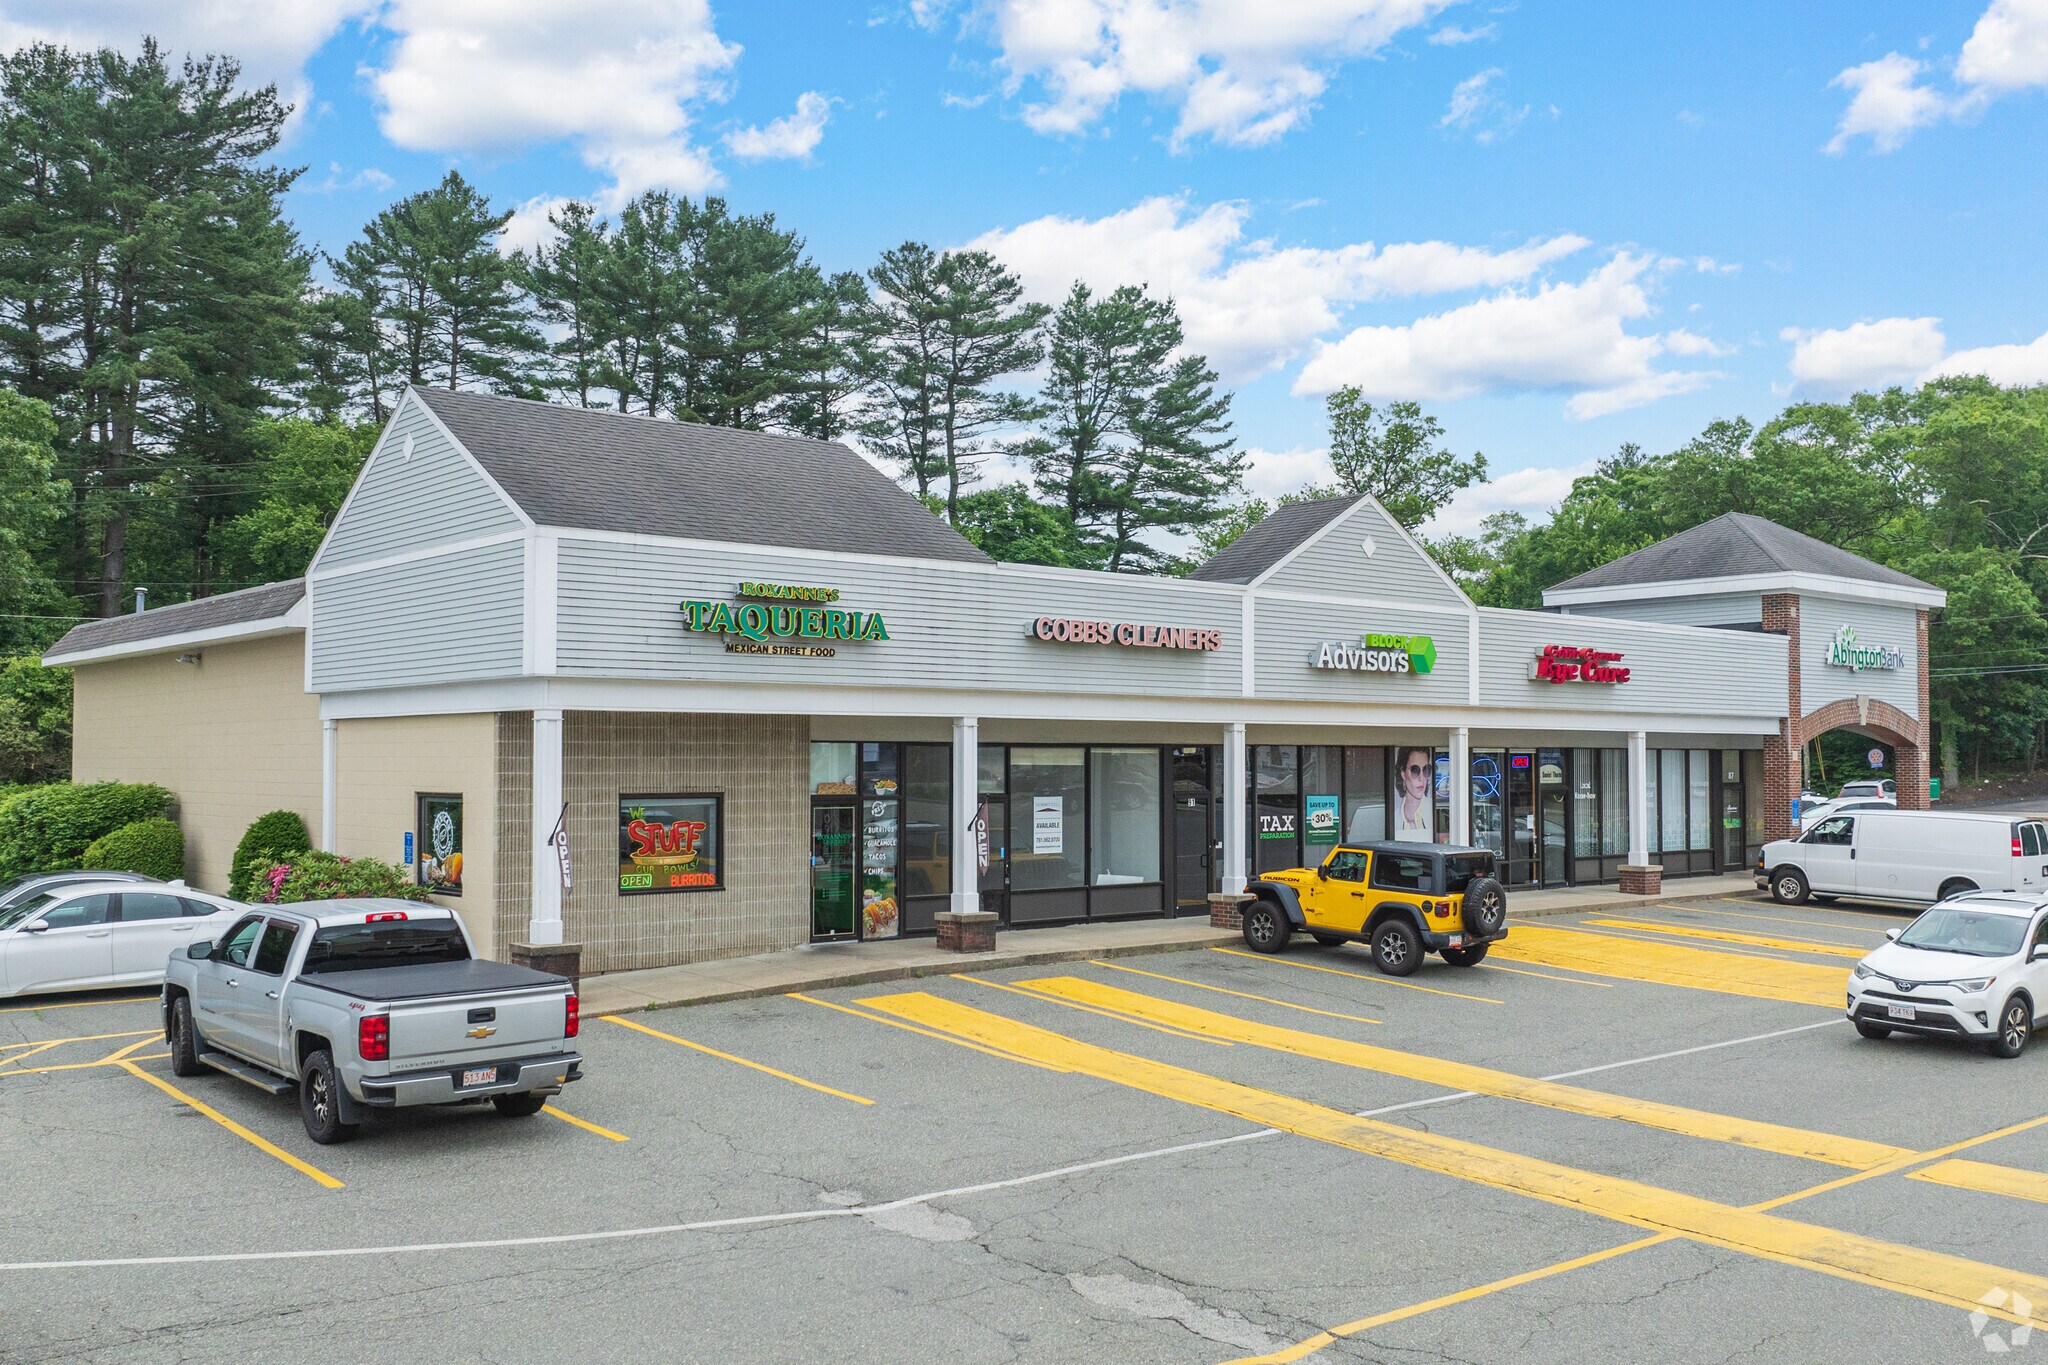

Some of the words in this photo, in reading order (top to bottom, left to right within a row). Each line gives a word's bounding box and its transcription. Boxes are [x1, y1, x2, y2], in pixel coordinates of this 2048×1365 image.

[742, 581, 840, 602] ROXANNE'S
[683, 600, 891, 642] TAQUERIA
[1035, 616, 1113, 645] COBBS
[1115, 622, 1222, 651] CLEANERS
[1370, 634, 1408, 648] BLOCK
[726, 643, 769, 655] MEXICAN
[772, 645, 806, 656] STREET
[810, 646, 836, 657] FOOD
[1317, 641, 1409, 673] Advisors
[1537, 656, 1579, 684] Eye
[1580, 659, 1631, 683] Care
[1513, 757, 1527, 767] OPEN
[629, 806, 645, 820] WE
[868, 825, 895, 834] BURRITOS
[1035, 821, 1061, 829] AVAILABLE
[1260, 815, 1295, 832] TAX
[628, 820, 707, 856] STUFF
[1259, 832, 1296, 840] PREPARATION
[977, 819, 988, 868] OPEN
[557, 830, 572, 888] OPEN
[868, 853, 886, 861] TACOS
[635, 864, 656, 874] OUR
[868, 867, 884, 876] CHIPS
[621, 876, 650, 886] OPEN
[670, 873, 716, 888] BURRITOS
[1263, 875, 1300, 883] RUBICON
[463, 1072, 480, 1084] 513
